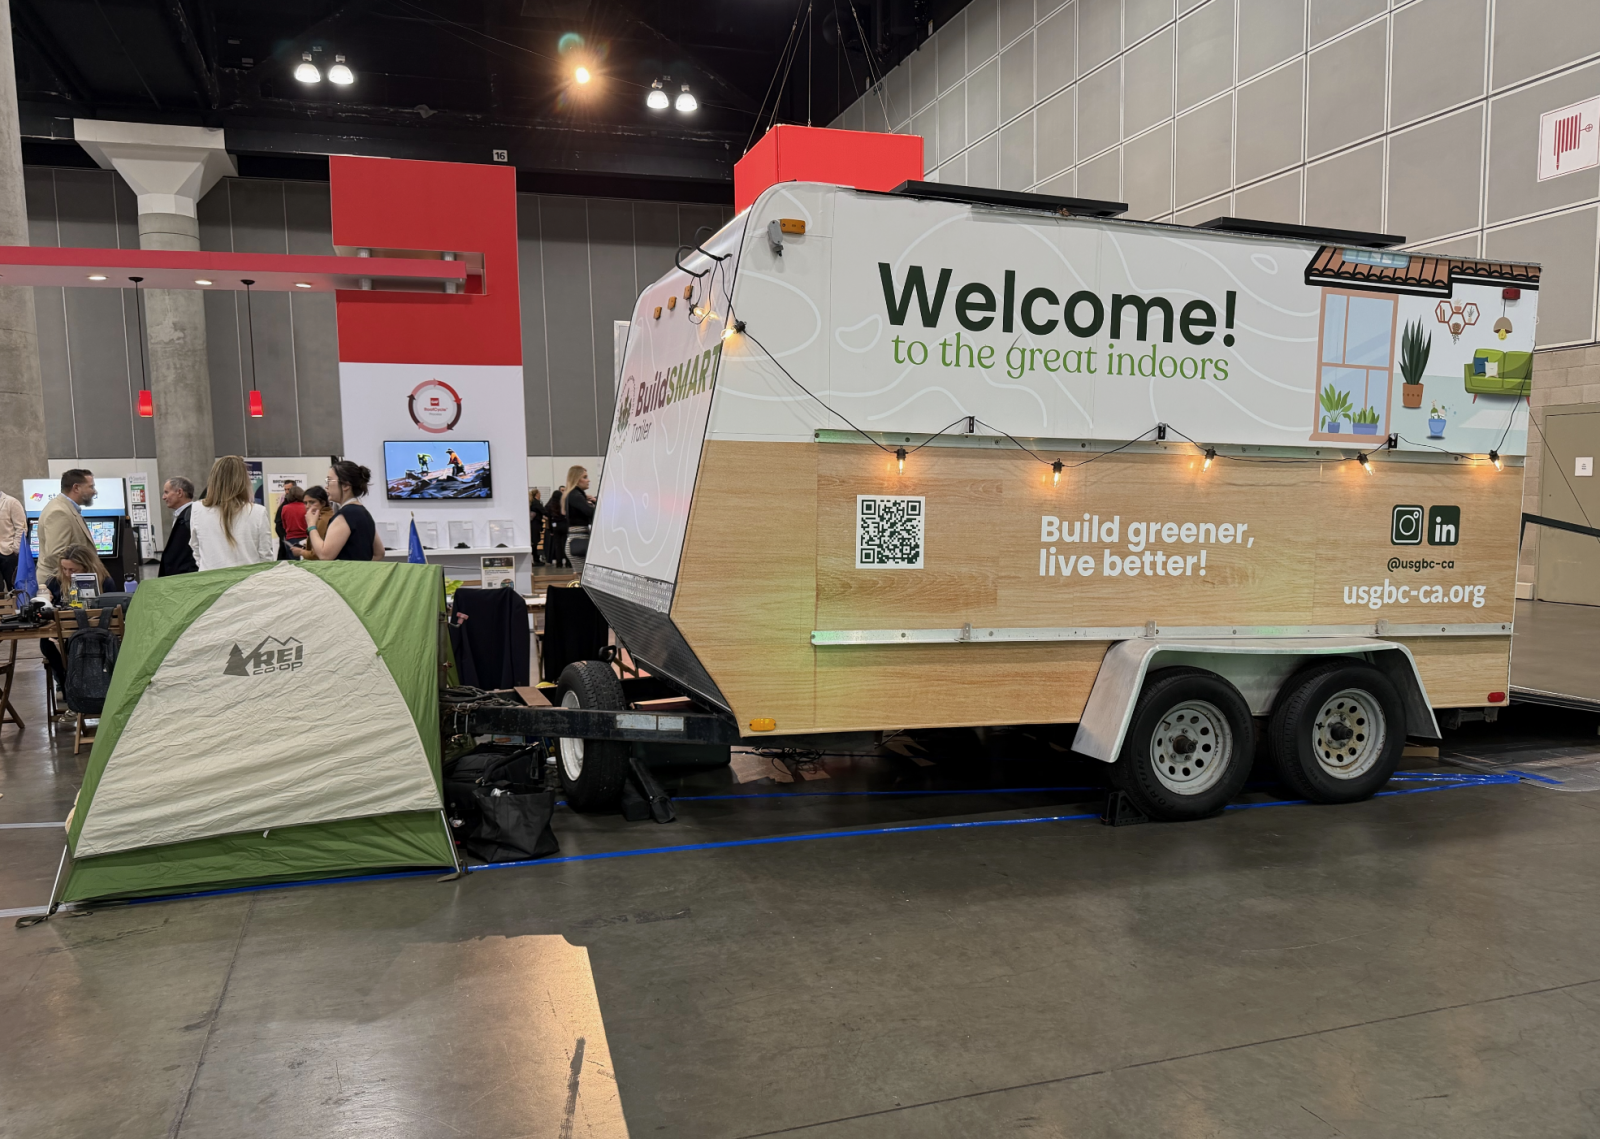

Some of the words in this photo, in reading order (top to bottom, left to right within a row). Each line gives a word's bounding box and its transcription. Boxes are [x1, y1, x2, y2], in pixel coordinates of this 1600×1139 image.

[494, 151, 506, 160] 16
[878, 262, 1237, 348] Welcome!
[891, 334, 928, 366] to
[939, 331, 996, 370] the
[1005, 344, 1098, 380] great
[1106, 343, 1230, 381] indoors
[630, 419, 652, 443] Trailer
[1040, 513, 1120, 543] Build
[1127, 521, 1255, 552] greener,
[1039, 547, 1096, 577] live
[1103, 549, 1207, 577] better!
[1387, 557, 1455, 572] @usgbc-ca
[1343, 578, 1487, 610] usgbc-ca.org
[253, 645, 304, 669] REI
